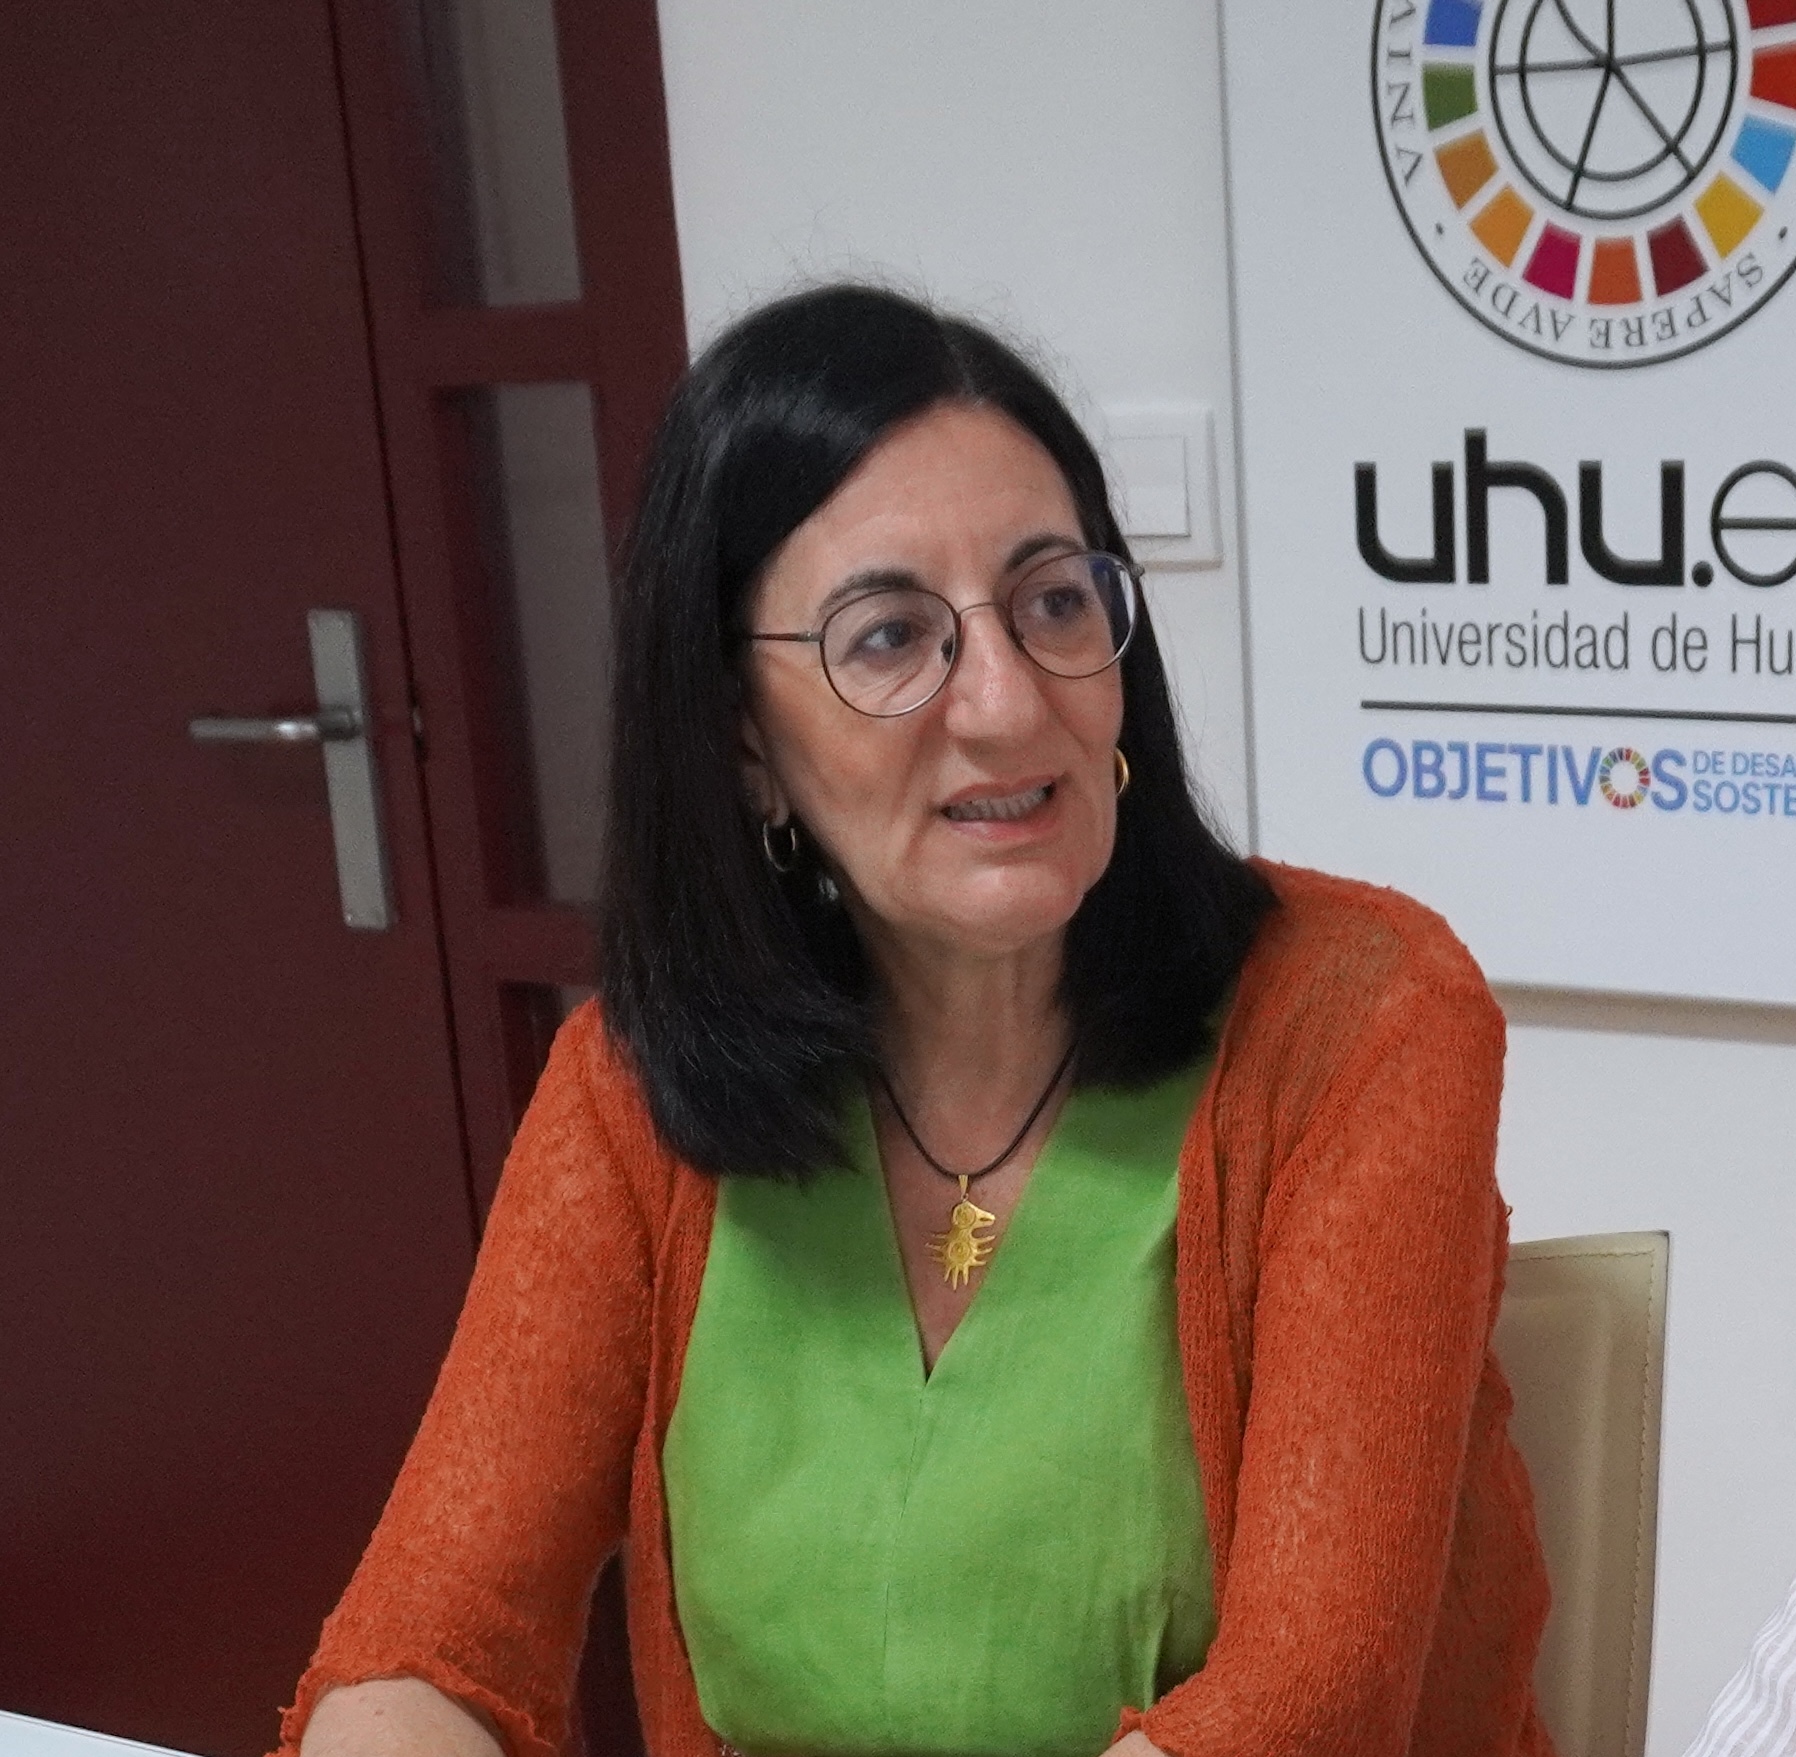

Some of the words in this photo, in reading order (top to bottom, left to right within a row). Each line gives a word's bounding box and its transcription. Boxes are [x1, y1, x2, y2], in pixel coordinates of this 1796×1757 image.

[1464, 254, 1574, 343] AVDE
[1589, 252, 1766, 349] SAPERE
[1358, 605, 1631, 672] Universidad
[1651, 611, 1708, 673] de
[1361, 736, 1690, 812] OBJETIVOS
[1692, 749, 1724, 777] DE
